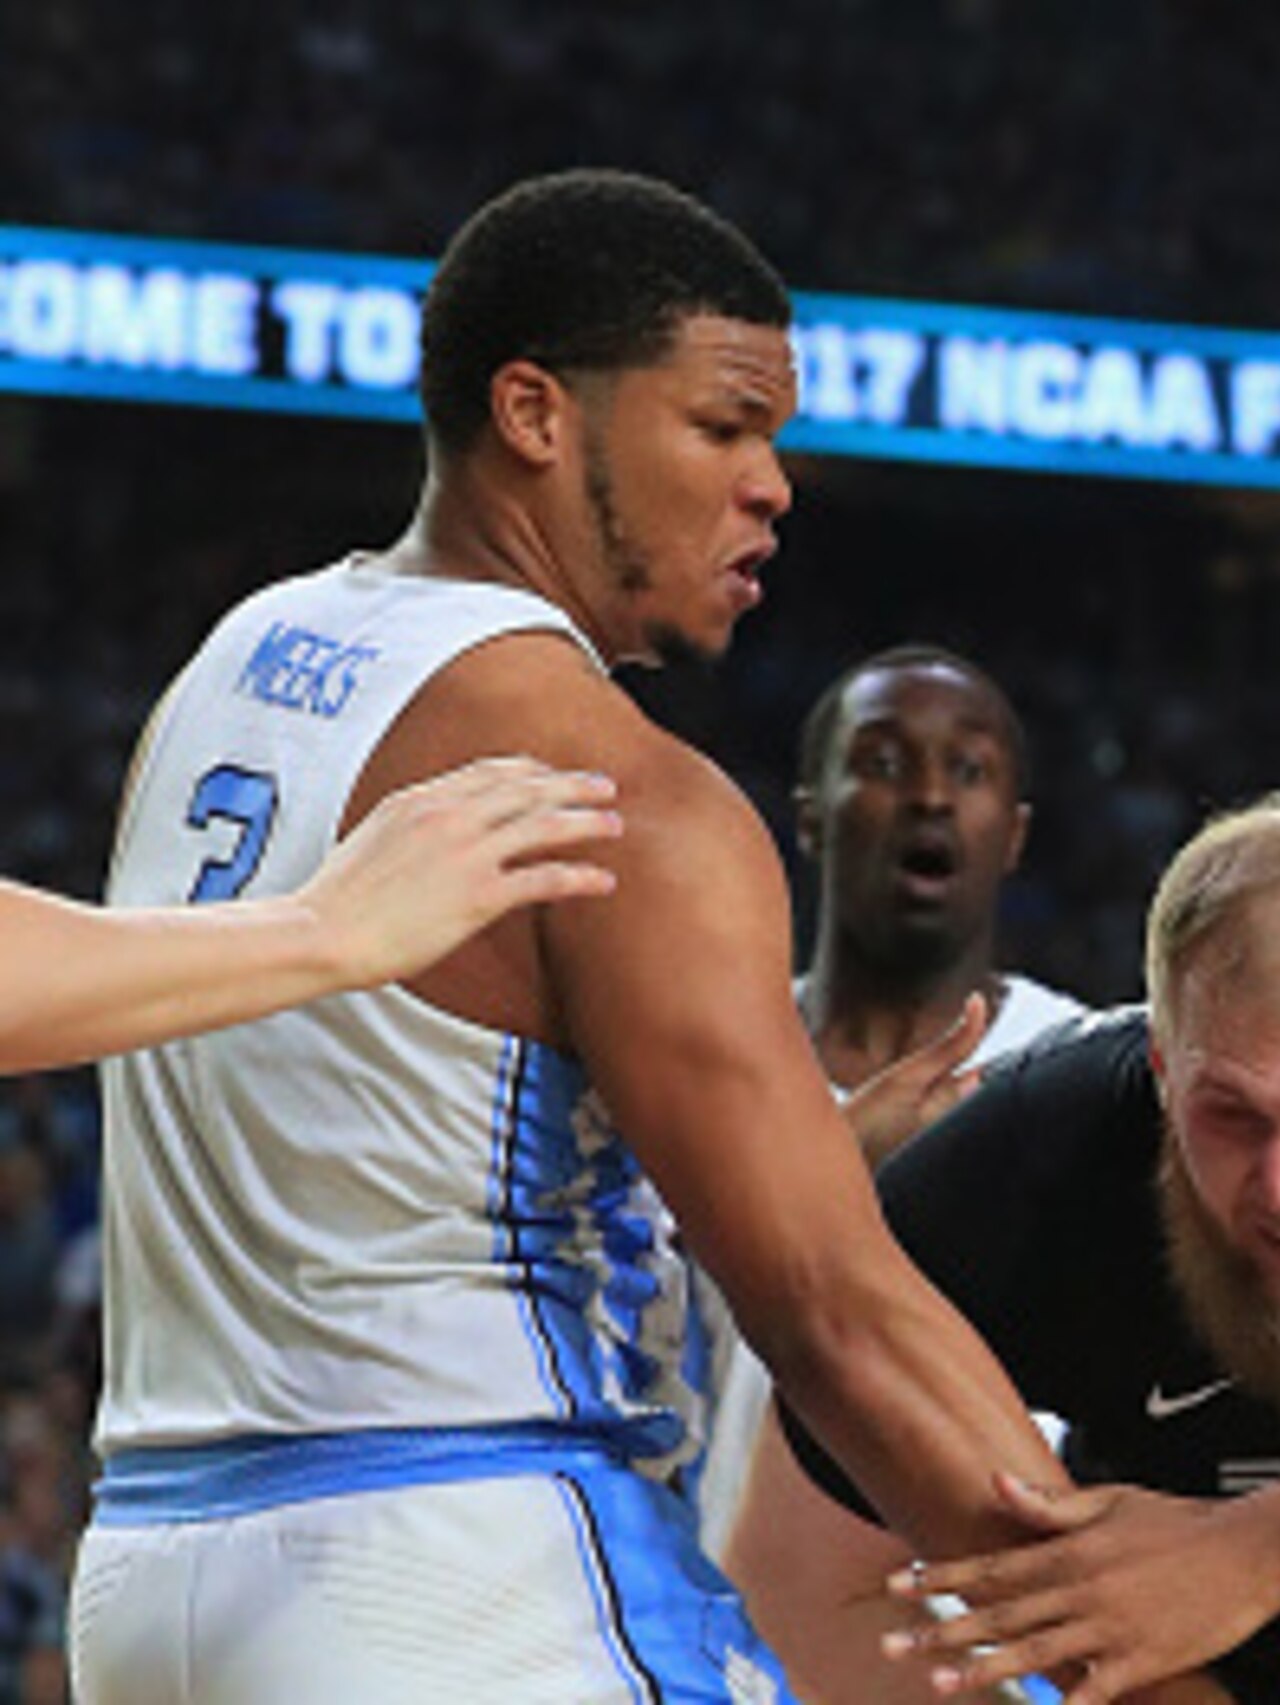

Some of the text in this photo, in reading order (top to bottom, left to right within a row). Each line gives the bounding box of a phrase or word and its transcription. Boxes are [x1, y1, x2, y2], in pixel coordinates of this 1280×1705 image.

[0, 262, 257, 374] OME
[270, 280, 422, 388] TO
[790, 323, 926, 424] 17
[934, 334, 1225, 453] NCAA
[233, 621, 380, 717] MEEKS
